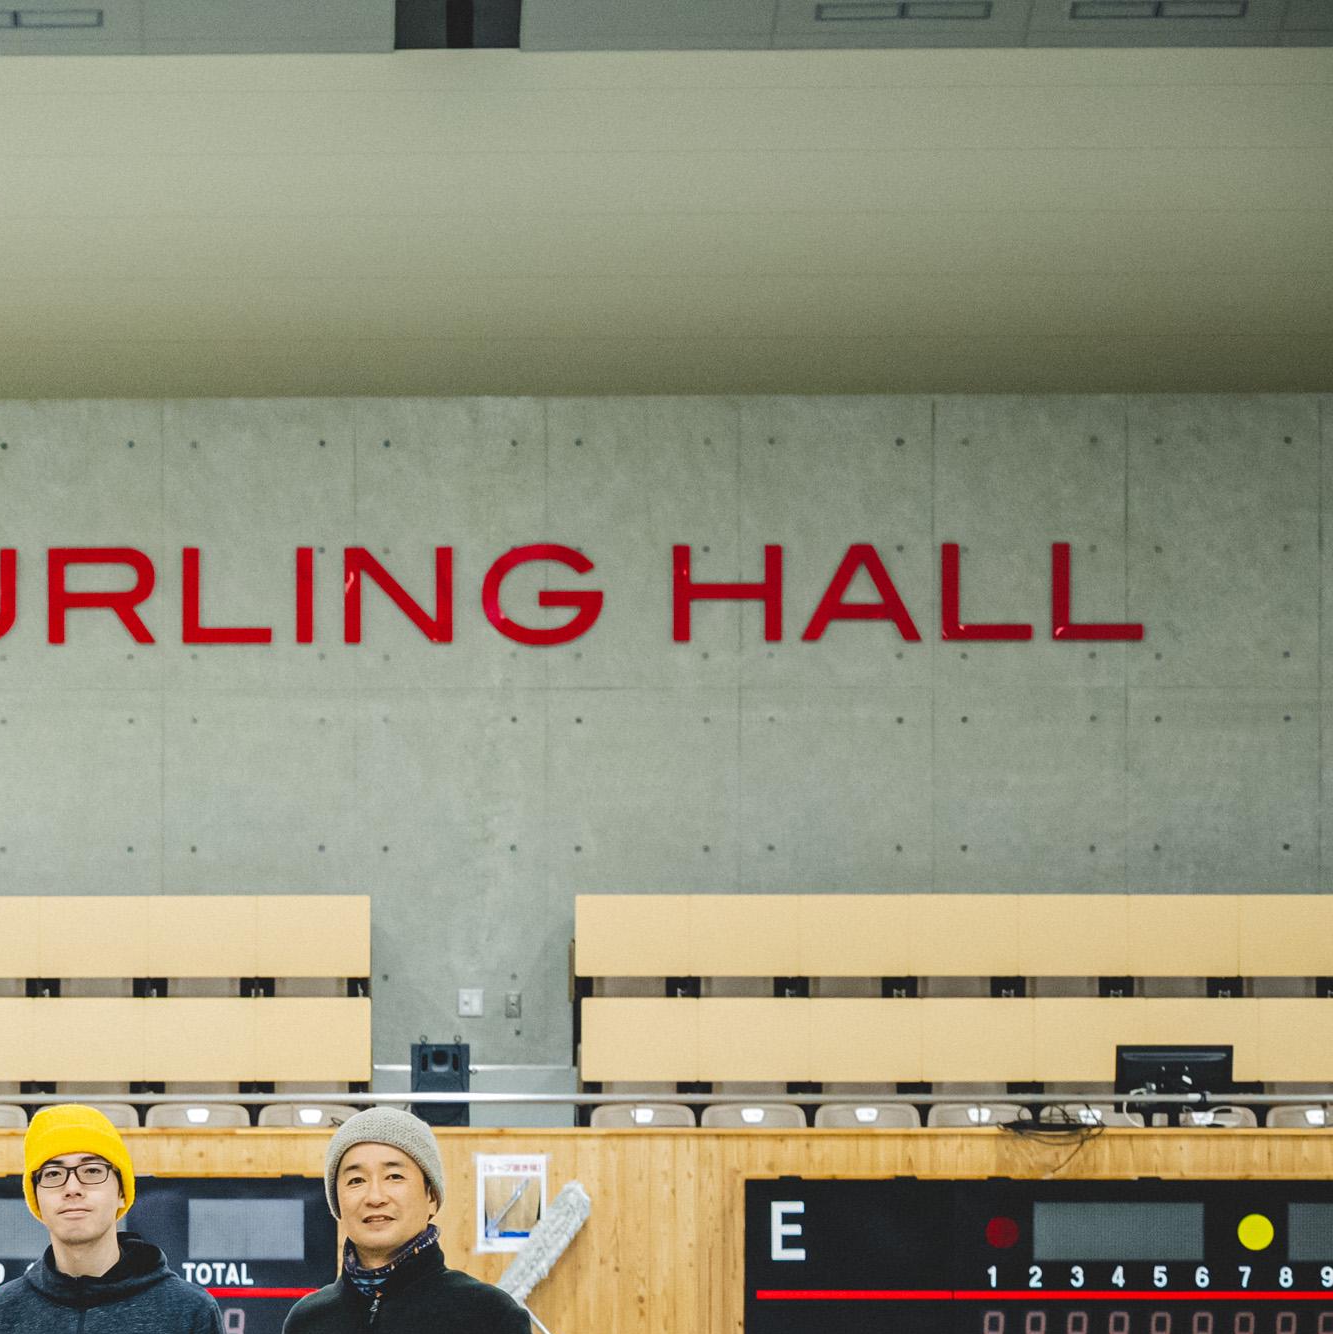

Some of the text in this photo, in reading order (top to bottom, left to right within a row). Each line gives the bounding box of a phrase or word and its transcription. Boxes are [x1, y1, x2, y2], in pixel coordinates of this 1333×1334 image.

[672, 543, 1145, 643] HALL
[770, 1200, 806, 1261] E
[182, 1262, 254, 1286] TOTAL
[987, 1265, 1333, 1288] 1 2 3 4 5 6 7 8 9
